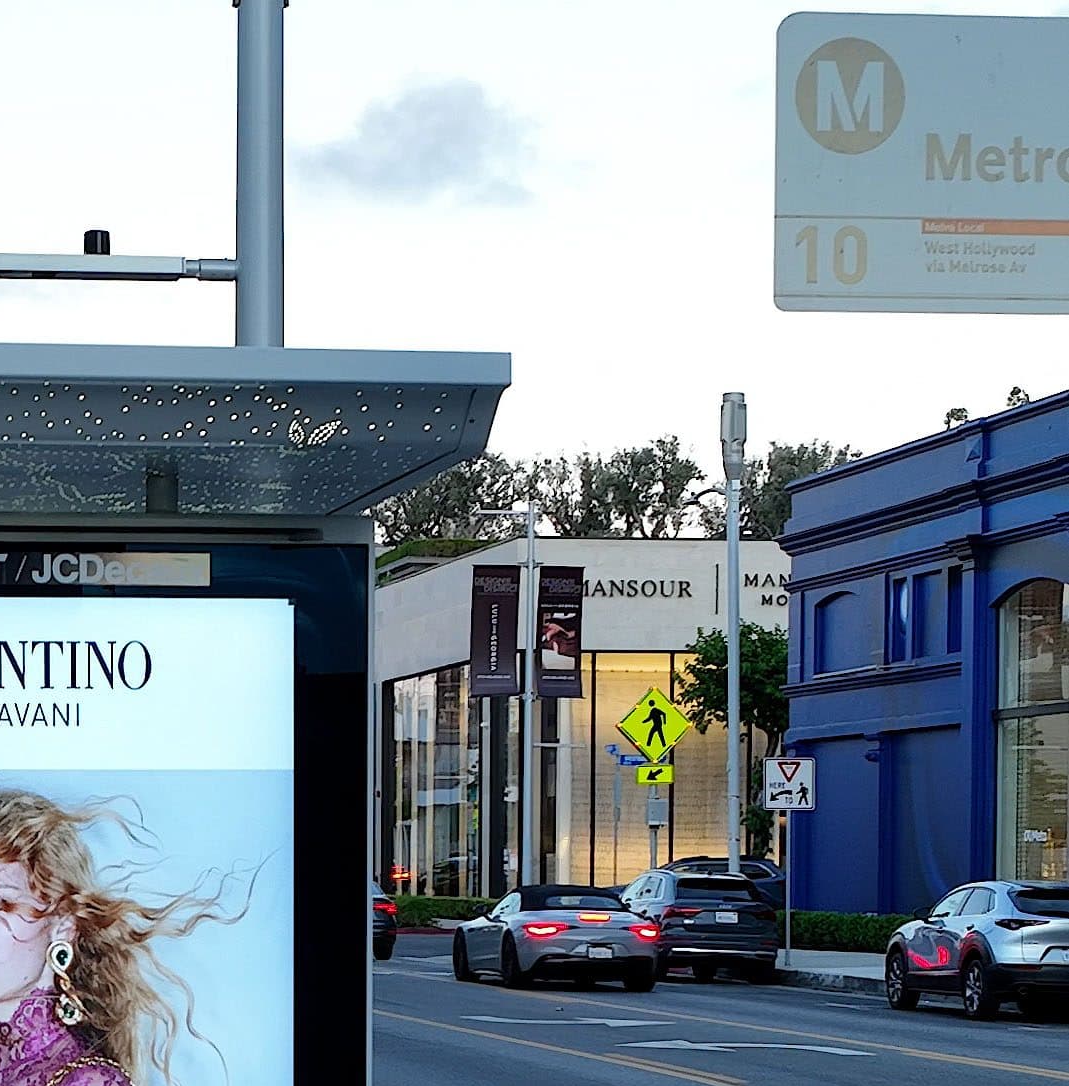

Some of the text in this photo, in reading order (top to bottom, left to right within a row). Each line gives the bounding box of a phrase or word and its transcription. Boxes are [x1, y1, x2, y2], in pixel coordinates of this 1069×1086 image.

[816, 60, 885, 133] M
[958, 222, 985, 233] Local
[795, 225, 868, 285] 10
[924, 241, 1036, 258] West Hollywood
[949, 260, 1006, 273] Melrose
[1009, 261, 1028, 273] Av
